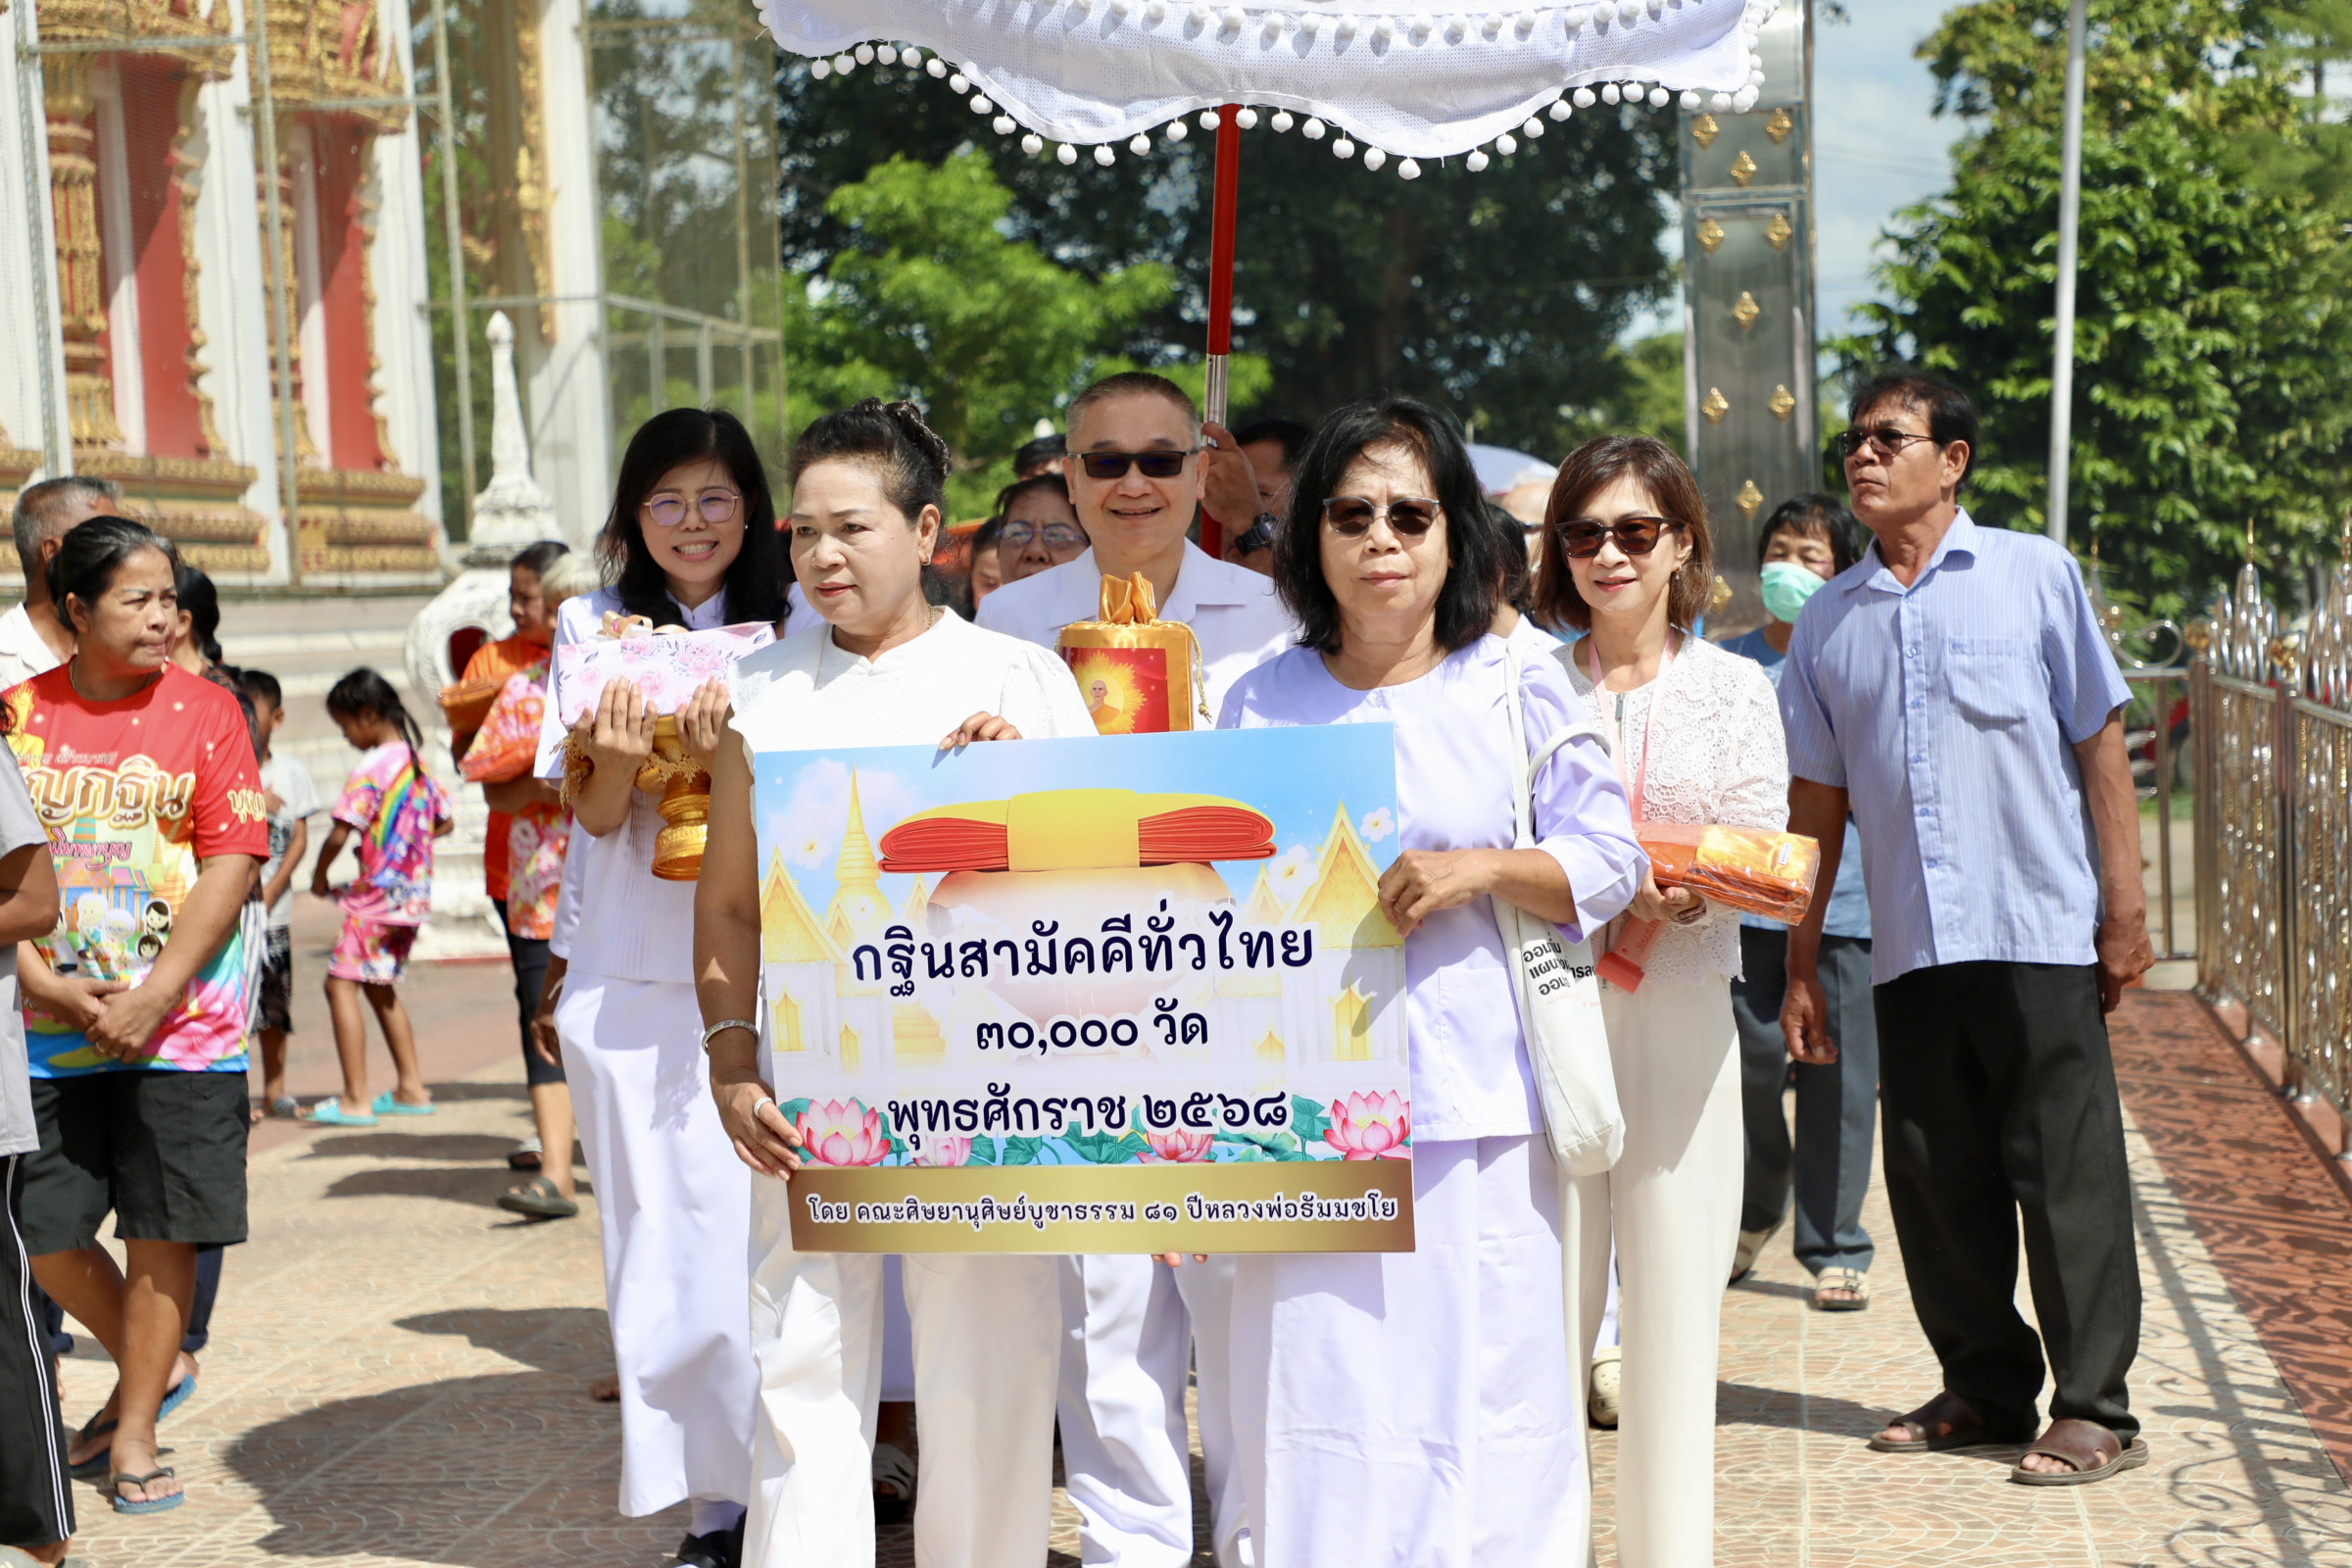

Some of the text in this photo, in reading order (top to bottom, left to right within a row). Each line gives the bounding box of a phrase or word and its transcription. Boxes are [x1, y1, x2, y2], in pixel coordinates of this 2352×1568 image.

[852, 898, 1313, 998] กฐินสามัคคีทั่วไทย
[976, 997, 1208, 1055] ๓๐,๐๐๐ วัด
[887, 1082, 1288, 1152] พุทธศักราช ๒๕๖๘
[808, 1192, 1396, 1229] โดย คณะศิษยานุศิษย์บูชาธรรม ๘๑ ปีหลวงพ่อธัมมชโย
